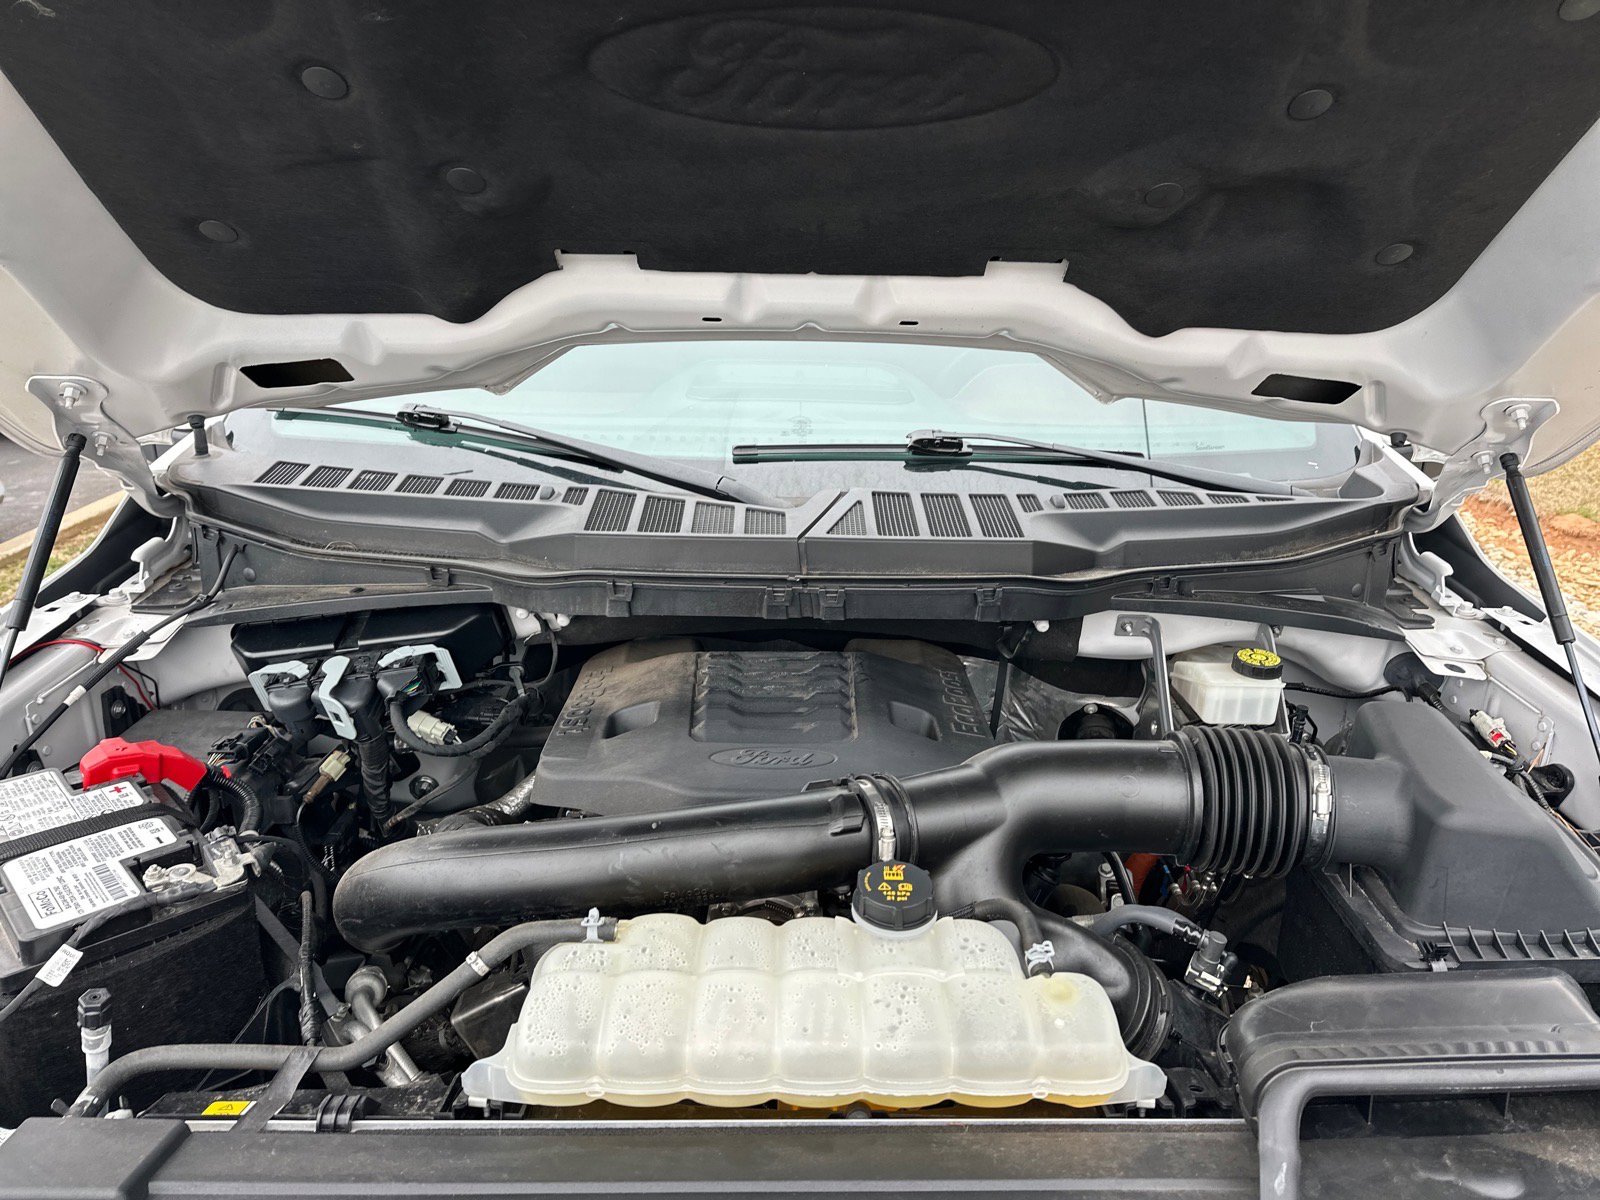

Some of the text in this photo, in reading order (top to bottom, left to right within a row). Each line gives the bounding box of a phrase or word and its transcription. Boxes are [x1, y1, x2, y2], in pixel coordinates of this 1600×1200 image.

[935, 667, 985, 737] EcoBoost
[732, 748, 814, 766] Ford
[36, 891, 57, 916] FoMoCo
